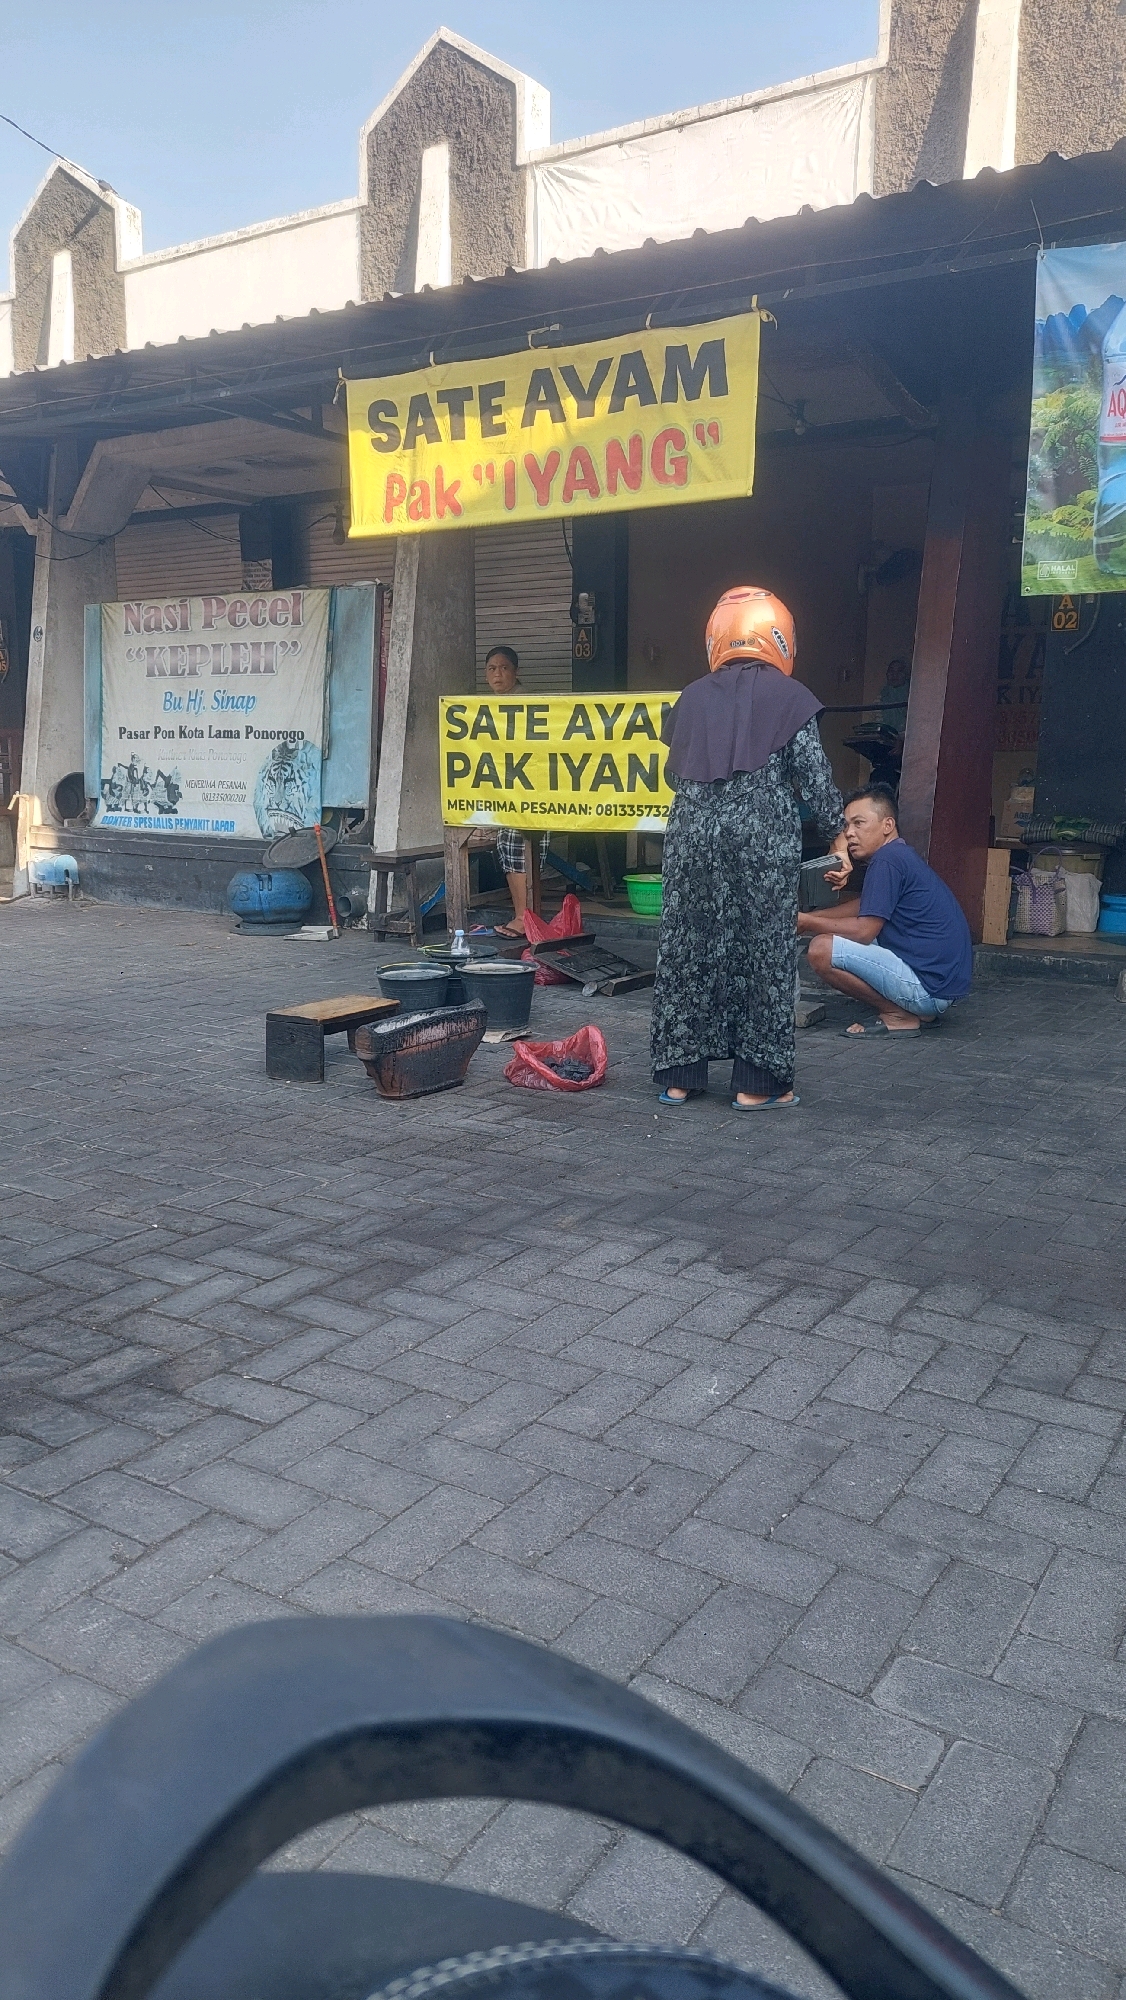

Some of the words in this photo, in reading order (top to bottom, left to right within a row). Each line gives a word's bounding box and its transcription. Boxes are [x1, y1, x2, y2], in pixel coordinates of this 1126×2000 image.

[367, 380, 506, 453] SATE
[521, 338, 729, 428] AYAM
[383, 464, 463, 524] Pak
[1051, 564, 1075, 572] HALAL
[1059, 594, 1074, 609] A
[123, 598, 191, 635] Nasi
[201, 592, 304, 629] Pecel
[1053, 611, 1077, 629] 02
[578, 629, 588, 641] A
[575, 643, 590, 658] 03
[163, 691, 182, 712] Bu
[187, 689, 206, 716] Hj.
[211, 689, 256, 715] Sinap
[445, 703, 550, 741] SATE
[118, 726, 150, 740] Pasar
[154, 725, 175, 739] Pon
[178, 725, 204, 739] Kota
[208, 725, 240, 740] Lama
[245, 725, 305, 743] Ponorogo
[446, 751, 535, 790] PAK
[185, 779, 216, 789] MENERIMA
[218, 780, 247, 790] PESANAN
[447, 799, 517, 814] MENERIMA
[521, 801, 592, 817] PESANAN:
[596, 803, 670, 818] 081335732
[134, 817, 173, 830] SPESIALIS
[175, 818, 210, 832] PENYAKIT
[211, 820, 235, 833] LAPAR
